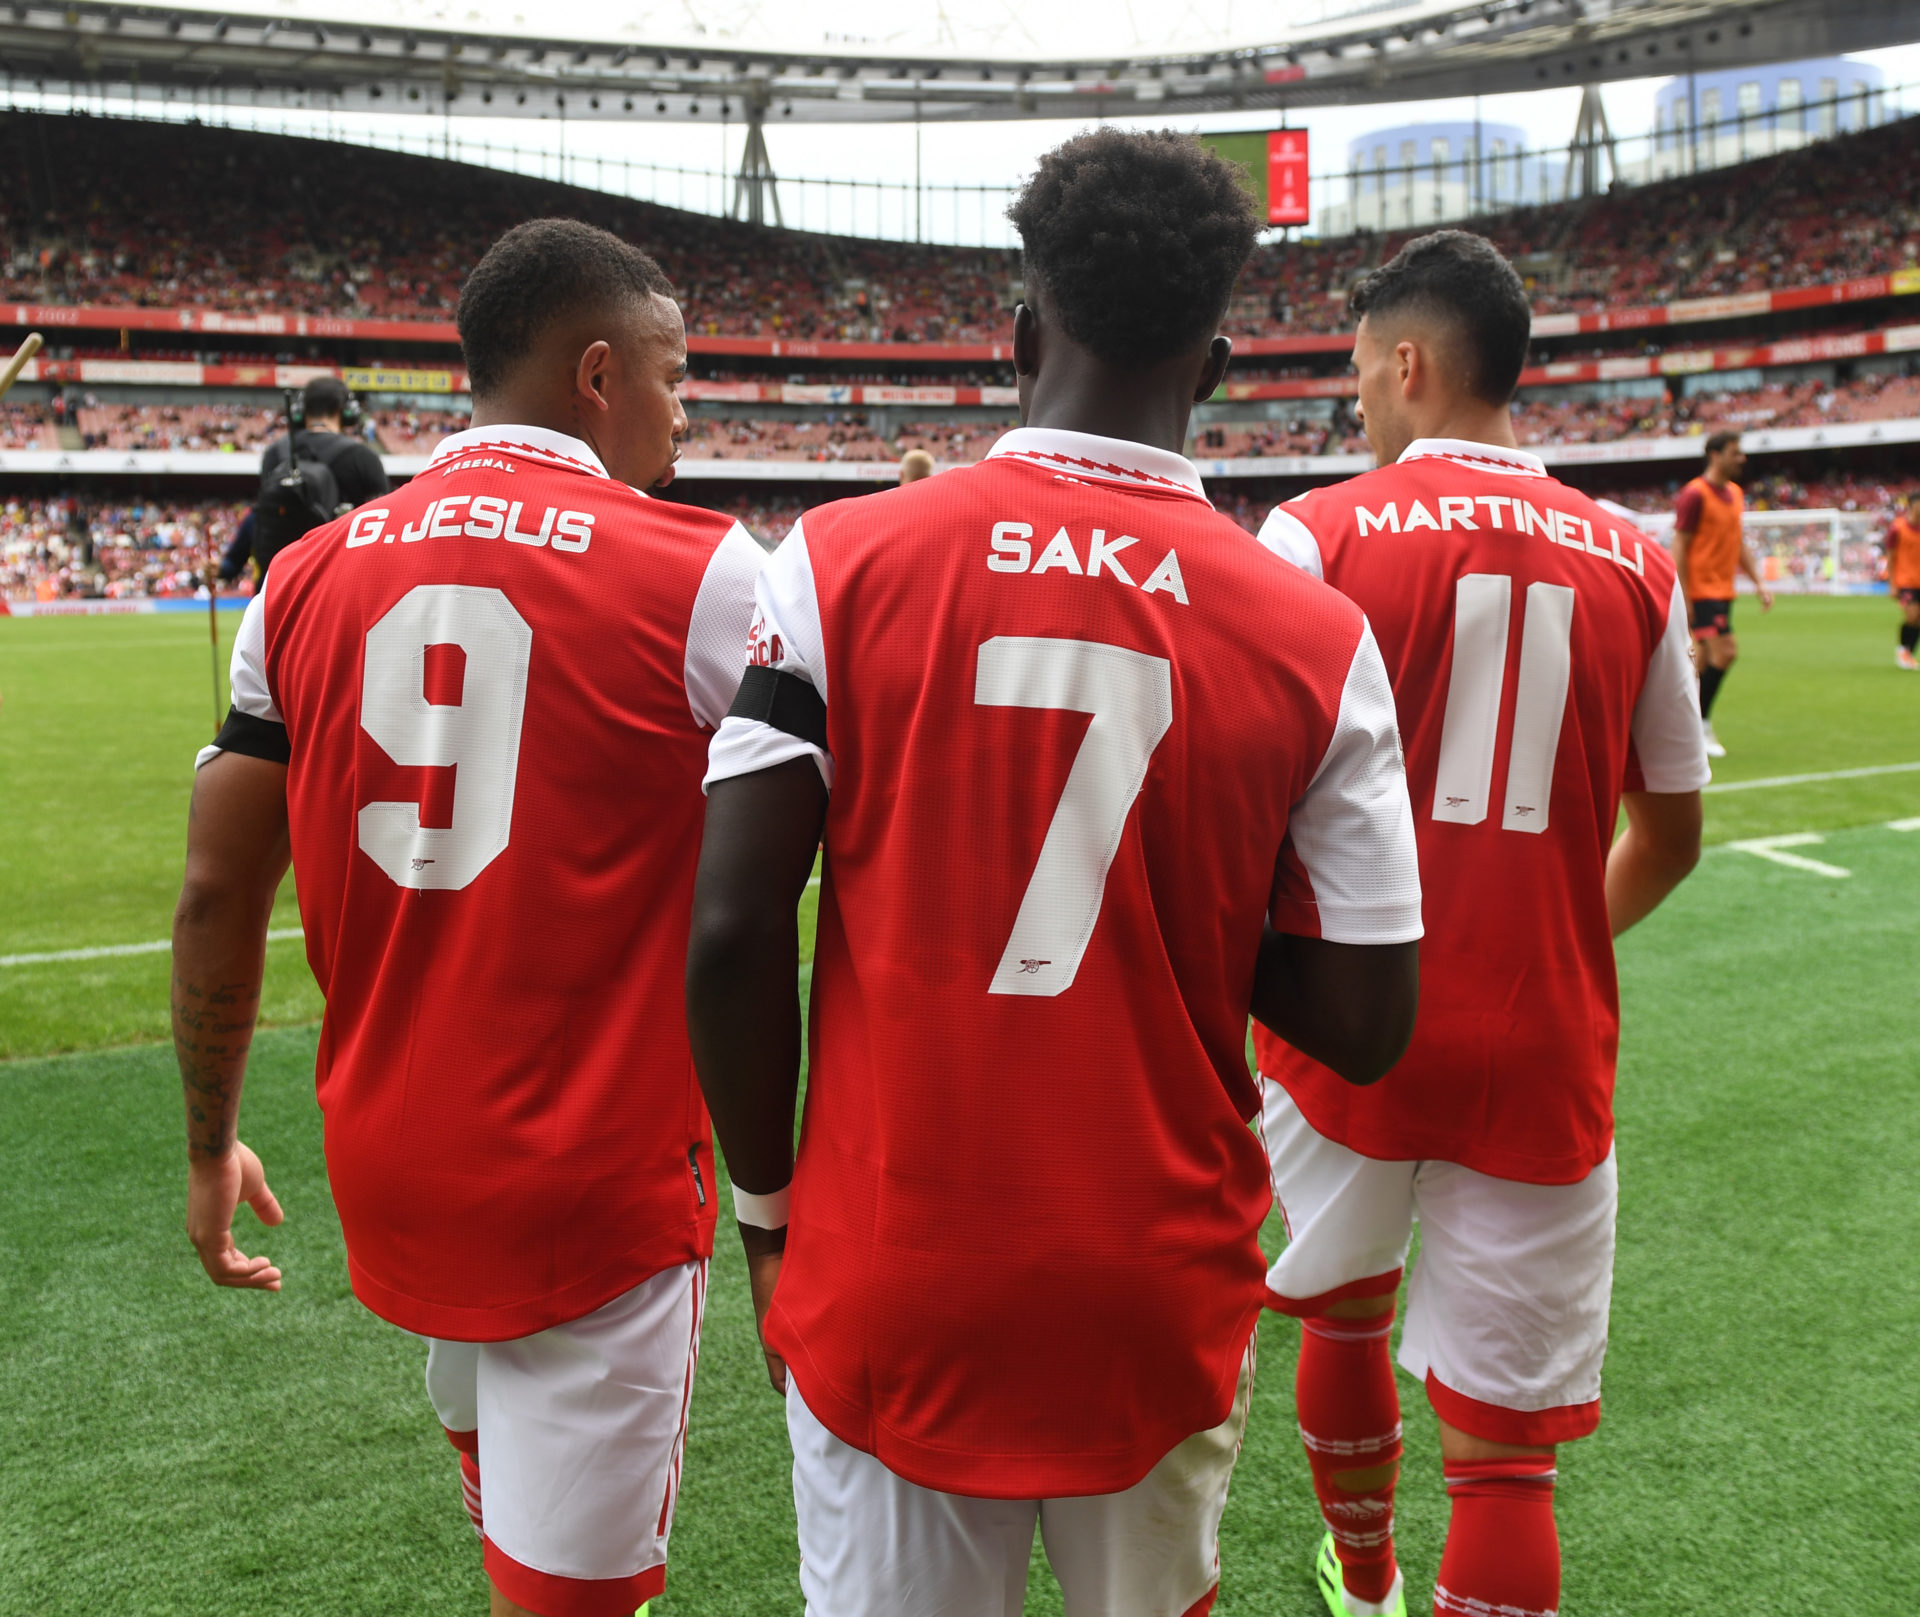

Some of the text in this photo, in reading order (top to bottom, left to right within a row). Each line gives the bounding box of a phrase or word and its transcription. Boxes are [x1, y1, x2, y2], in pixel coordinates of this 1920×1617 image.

[442, 457, 516, 478] ARSENAL
[343, 494, 597, 555] G.JESUS
[986, 521, 1190, 606] SAKA
[1354, 495, 1645, 577] MARTINELLI
[357, 583, 534, 891] 9
[1431, 572, 1575, 834] 11
[973, 635, 1173, 997] 7
